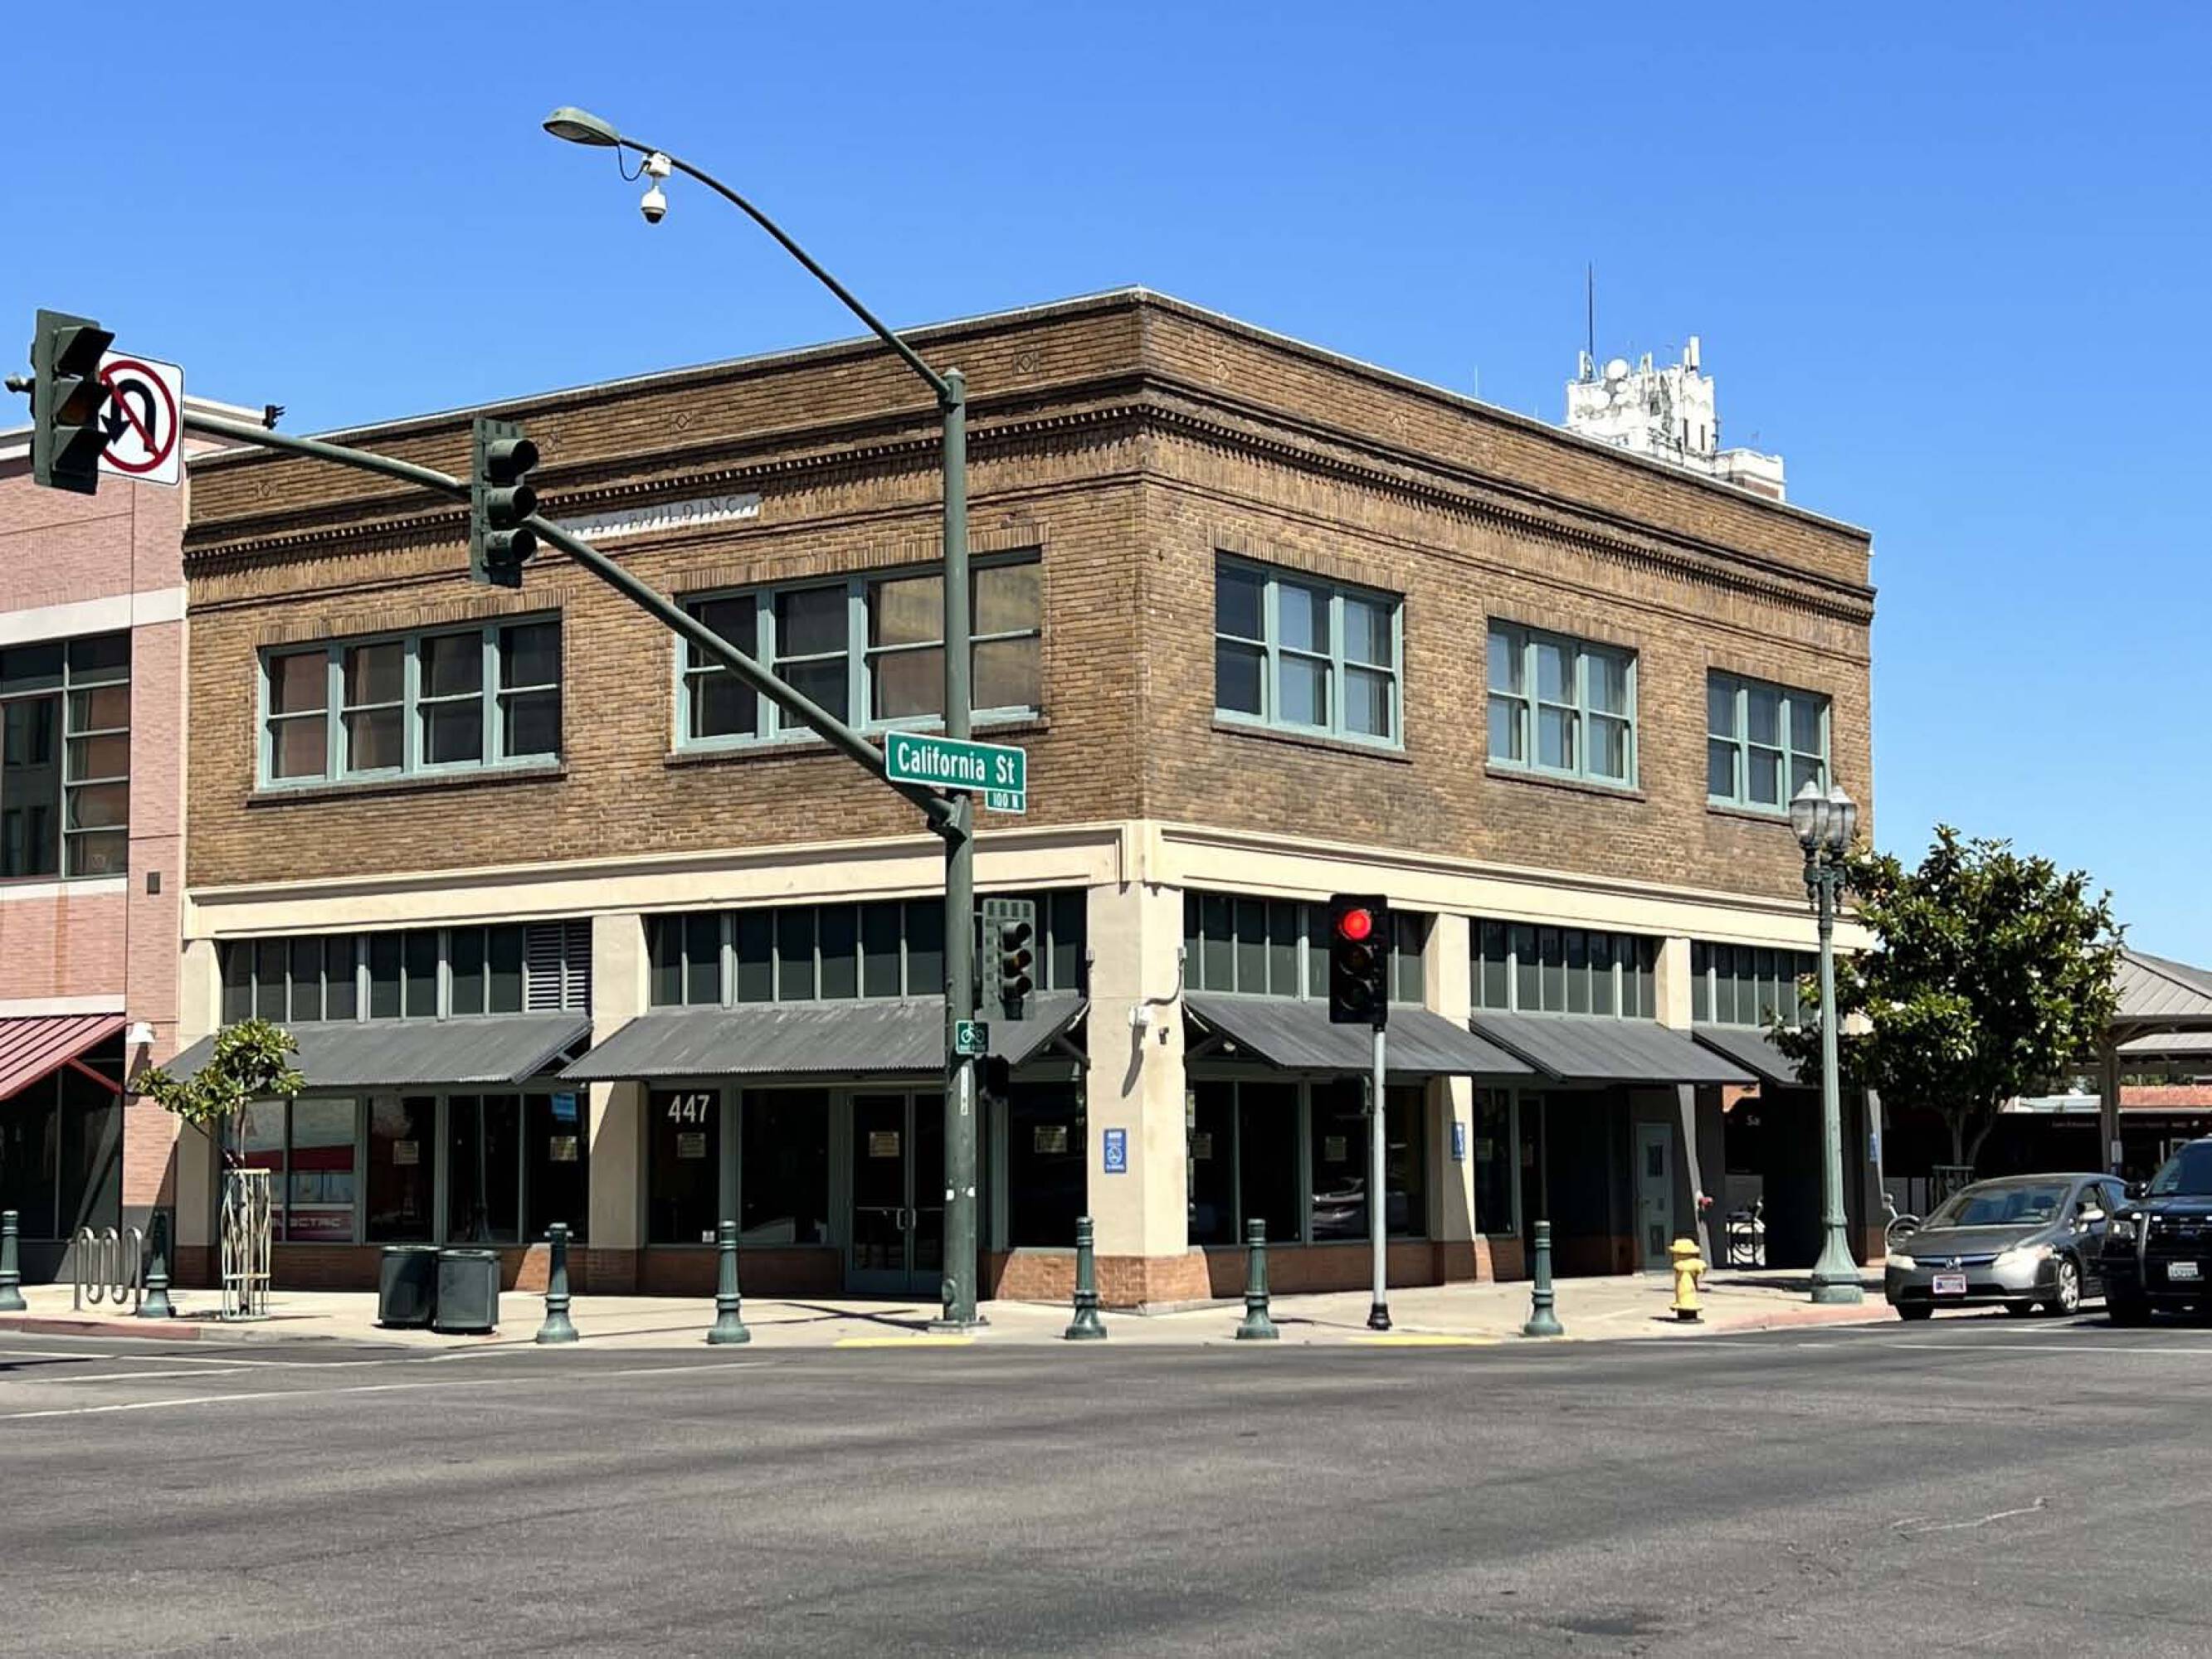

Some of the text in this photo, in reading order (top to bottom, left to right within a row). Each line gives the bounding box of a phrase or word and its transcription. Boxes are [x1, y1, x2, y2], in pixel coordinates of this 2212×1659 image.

[898, 742, 1015, 785] California St
[992, 791, 1008, 808] 100
[668, 1094, 710, 1123] 447
